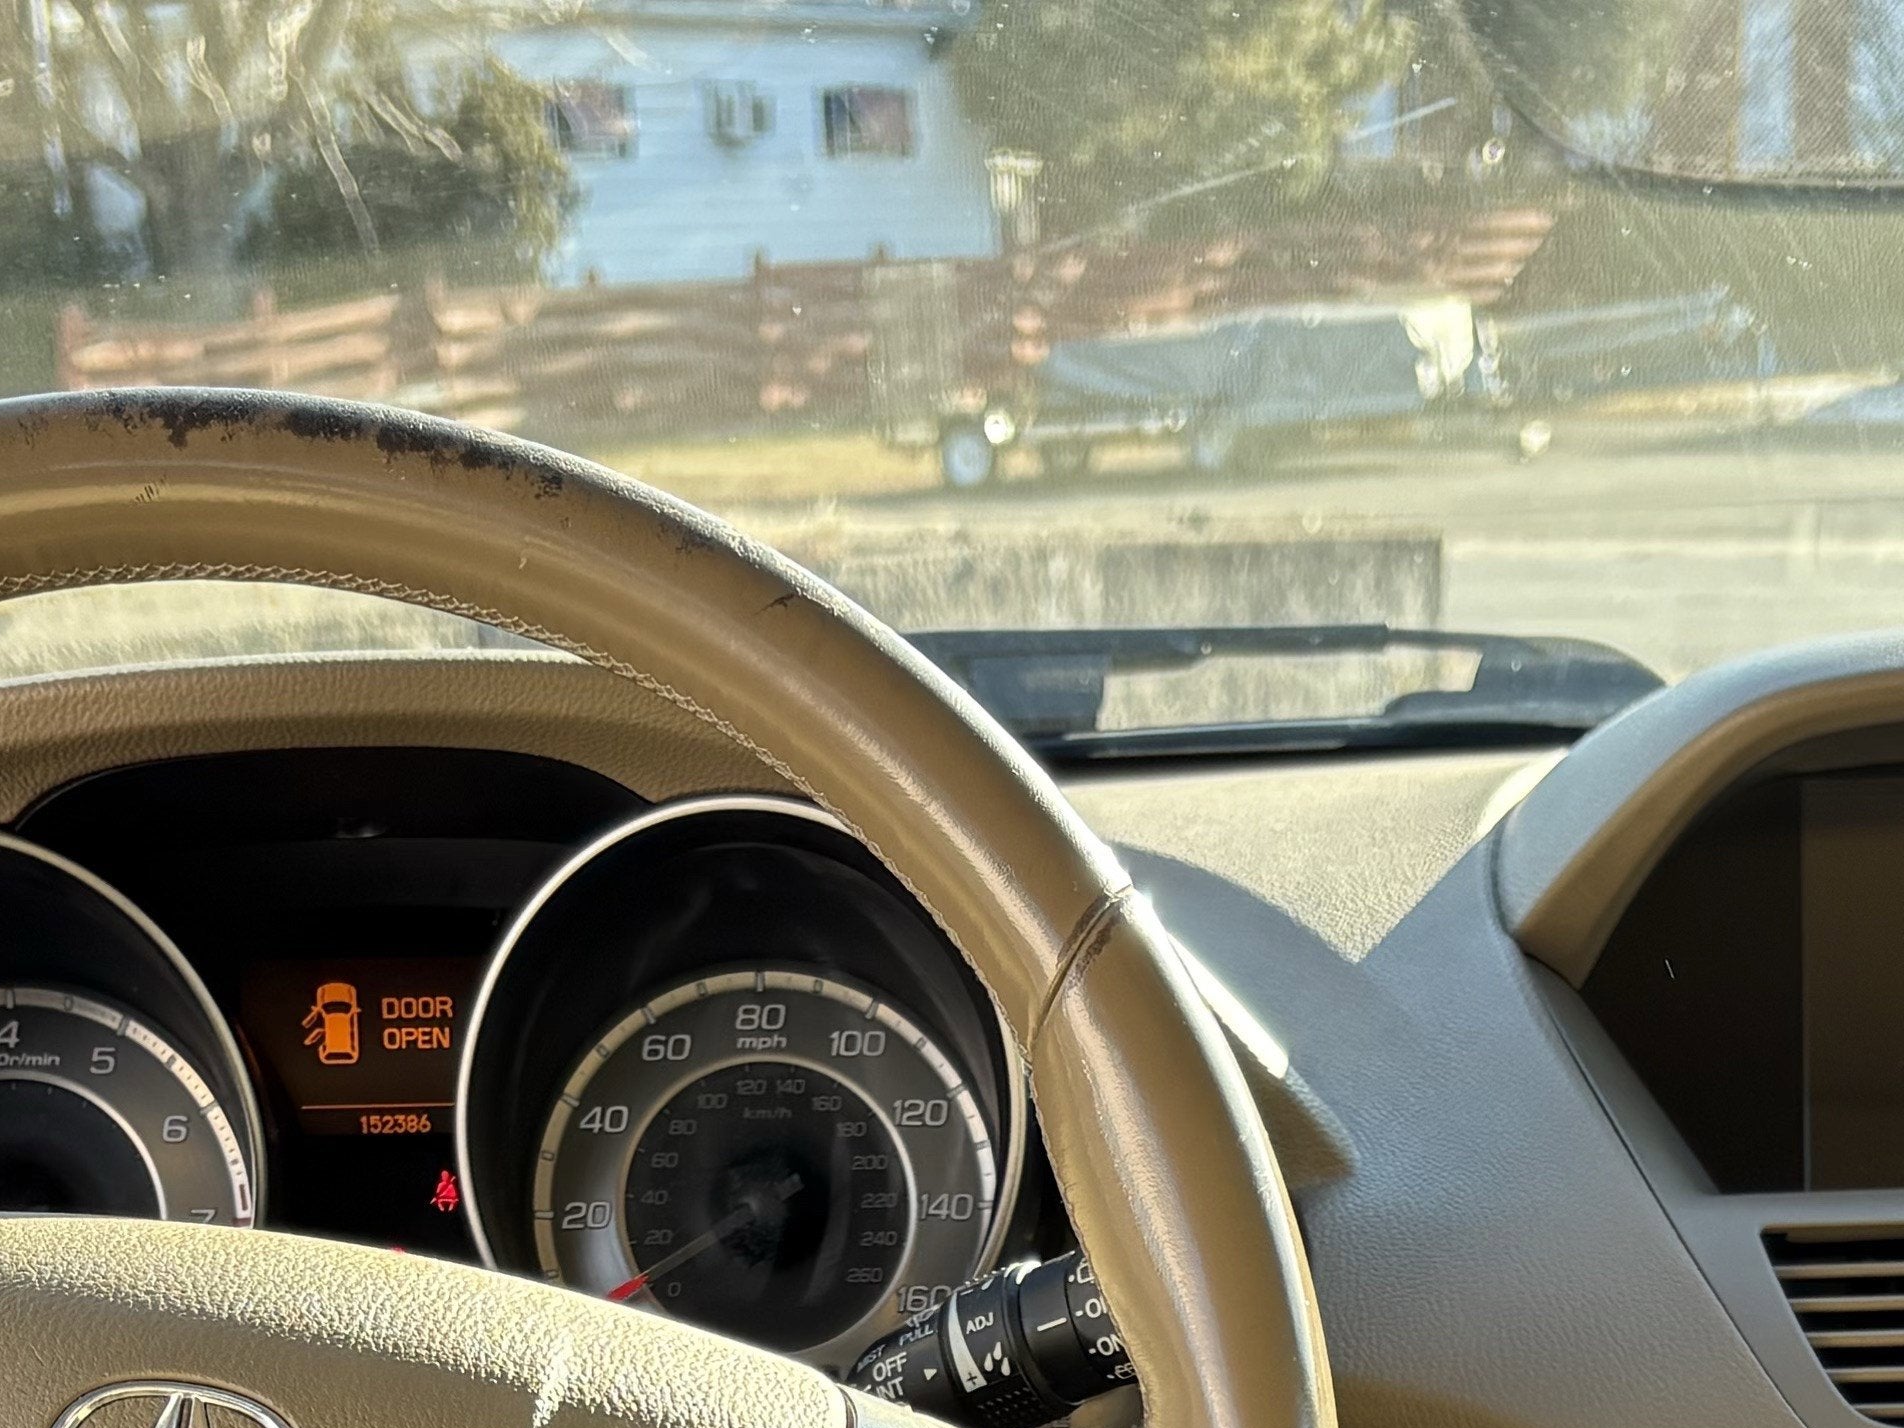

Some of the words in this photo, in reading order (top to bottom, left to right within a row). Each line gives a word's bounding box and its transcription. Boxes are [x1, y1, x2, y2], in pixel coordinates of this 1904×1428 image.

[381, 997, 453, 1019] DOOR
[735, 1004, 786, 1031] 80
[383, 1027, 450, 1049] OPEN
[642, 1034, 691, 1061] 60
[736, 1035, 786, 1052] mph
[829, 1031, 885, 1057] 100
[90, 1047, 116, 1075] 5
[736, 1079, 766, 1094] 120
[776, 1078, 805, 1094] 140
[696, 1094, 726, 1109] 100
[580, 1106, 628, 1133] 40
[742, 1105, 792, 1121] km/h
[894, 1100, 947, 1126] 120
[162, 1115, 188, 1143] 6
[359, 1114, 431, 1134] 152386
[669, 1120, 695, 1135] 80
[651, 1152, 678, 1168] 60
[852, 1155, 888, 1170] 200
[640, 1190, 668, 1205] 40
[916, 1193, 972, 1221] 140
[562, 1202, 612, 1229] 20
[644, 1230, 672, 1245] 20
[860, 1232, 896, 1247] 240
[667, 1281, 681, 1297] 0
[966, 1312, 994, 1335] ADJ
[873, 1352, 907, 1381] OFF
